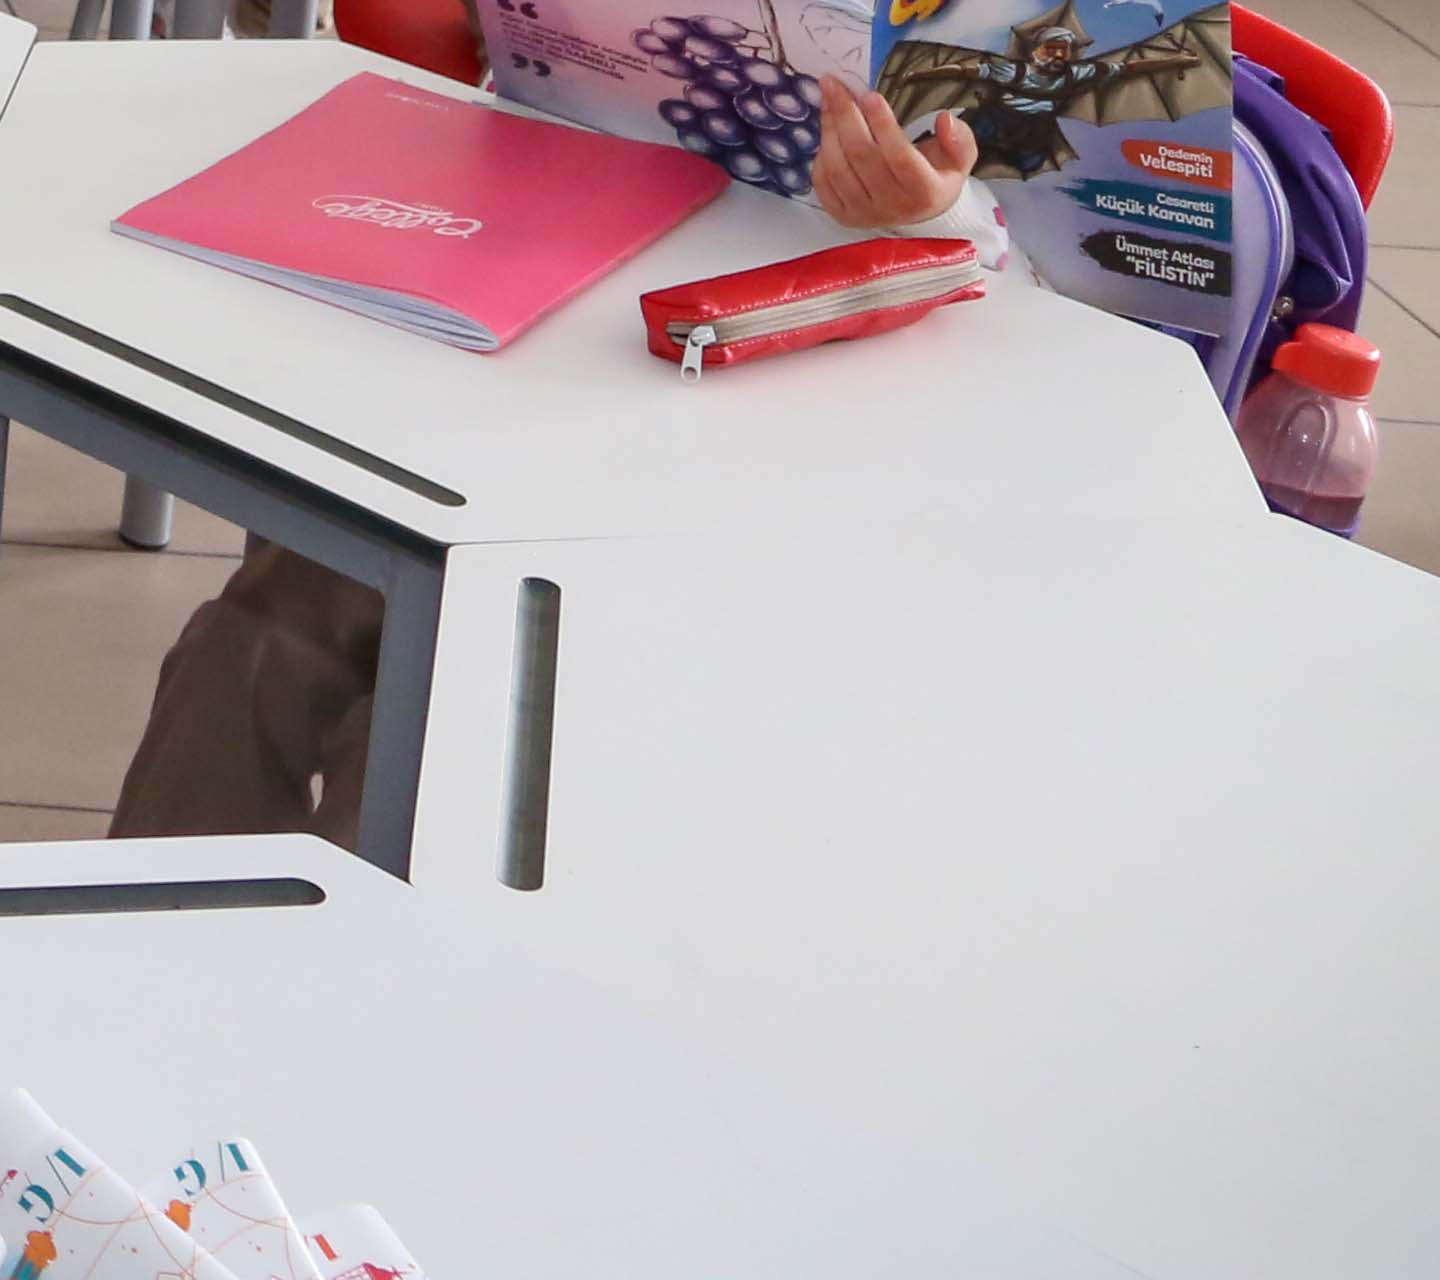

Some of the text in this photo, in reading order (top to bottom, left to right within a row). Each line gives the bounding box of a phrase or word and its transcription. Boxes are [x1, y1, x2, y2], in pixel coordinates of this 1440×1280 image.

[1140, 153, 1214, 178] Velespiti
[1158, 145, 1214, 164] Dedemin
[1095, 194, 1215, 229] Küçük Karavan
[1156, 192, 1214, 214] Cesaretli
[1115, 235, 1215, 270] Ümmet Atlası
